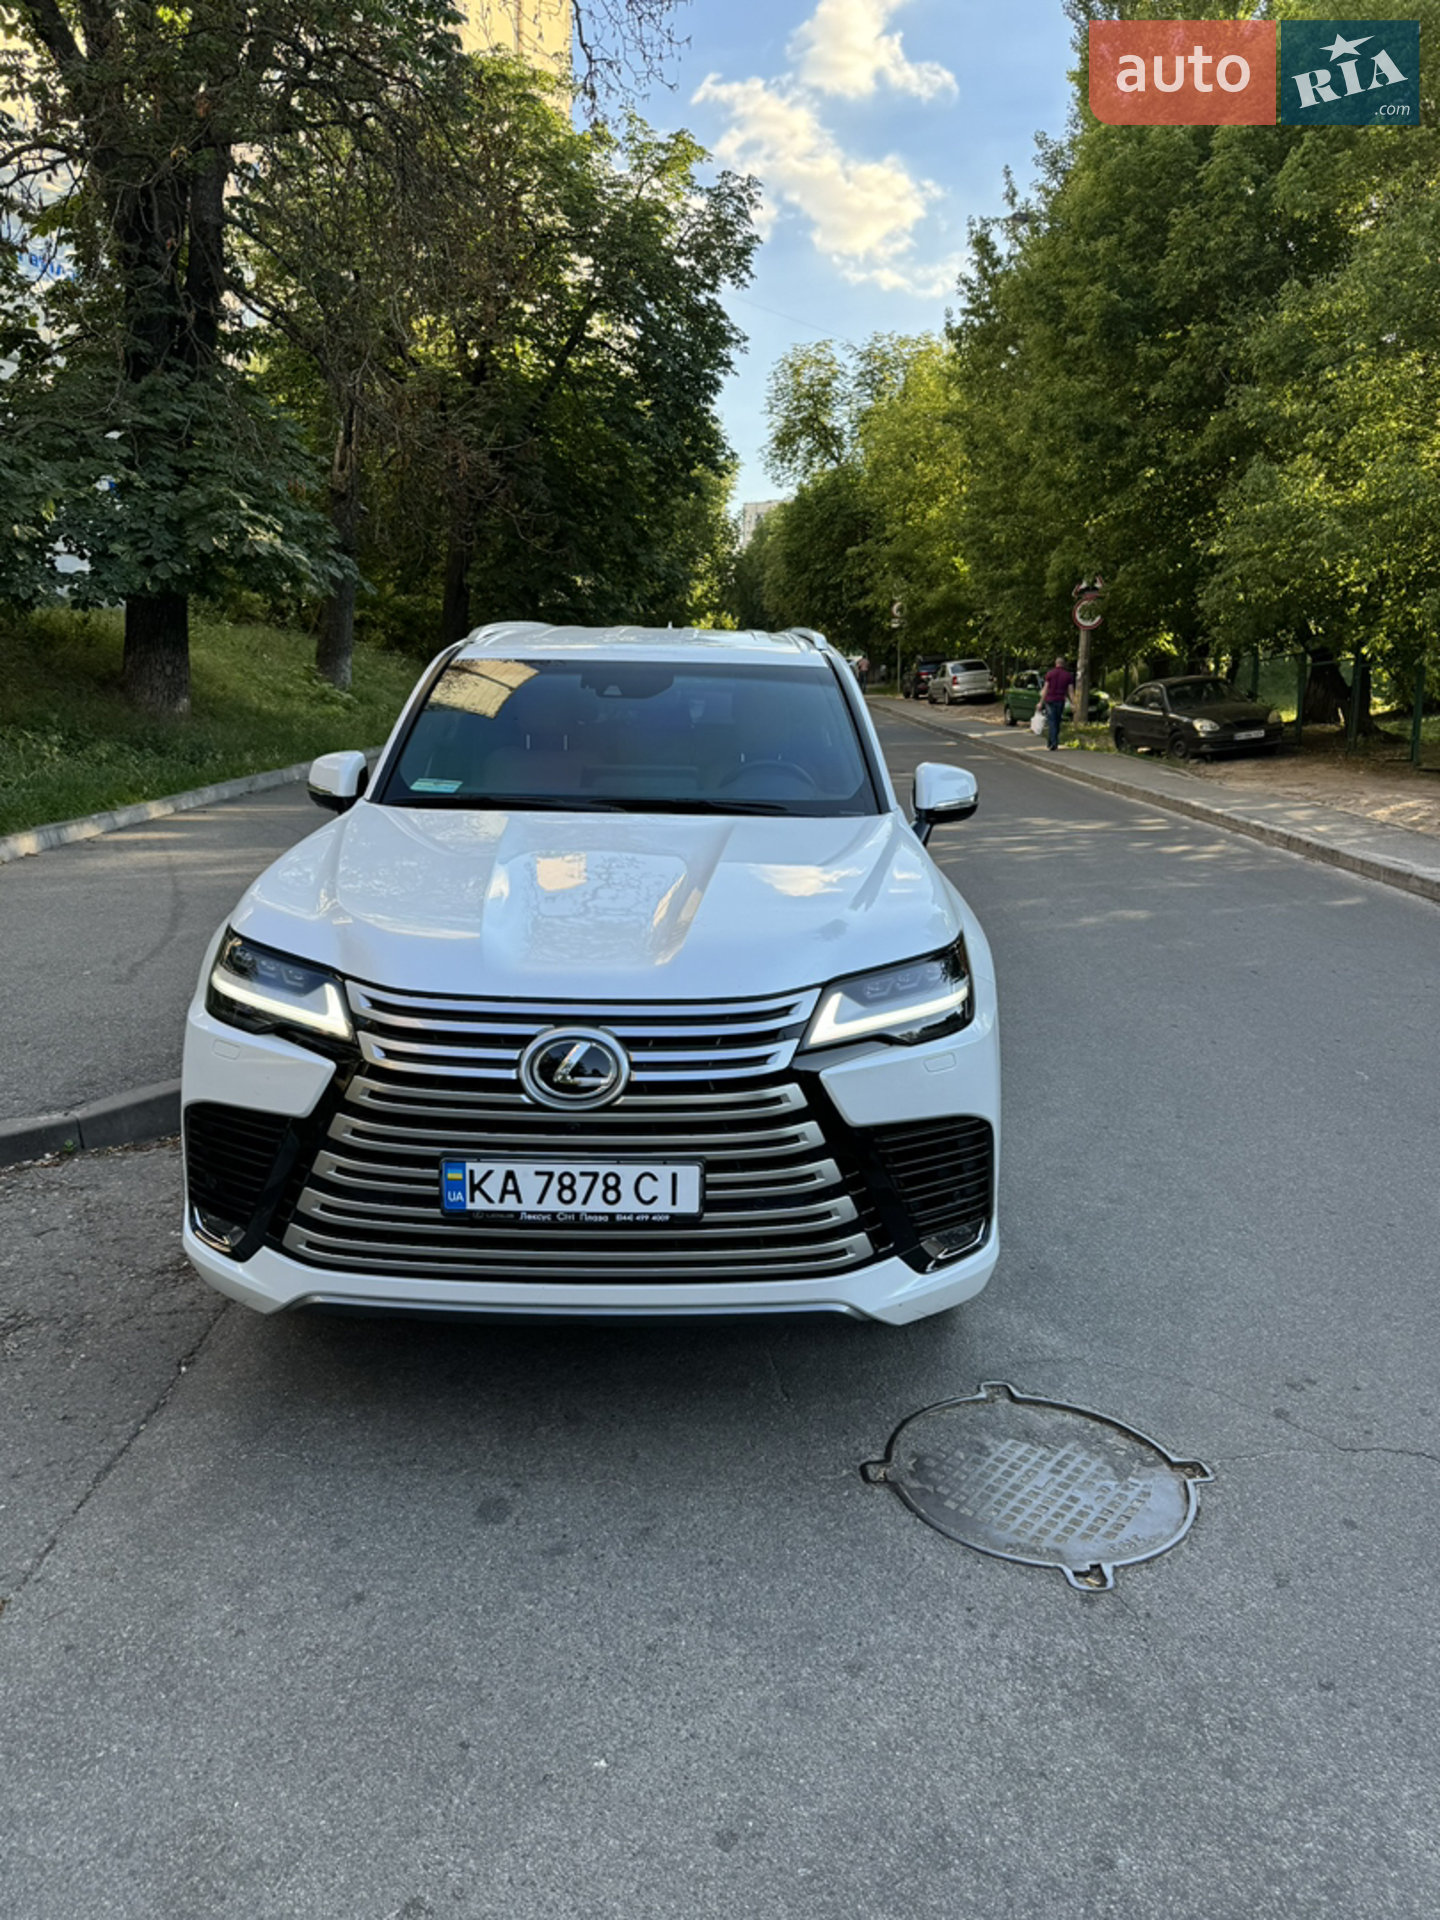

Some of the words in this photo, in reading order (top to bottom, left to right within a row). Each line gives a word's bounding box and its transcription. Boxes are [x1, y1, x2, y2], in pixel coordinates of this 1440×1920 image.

[447, 1190, 464, 1202] UA
[468, 1169, 523, 1204] KA
[534, 1171, 622, 1206] 7878
